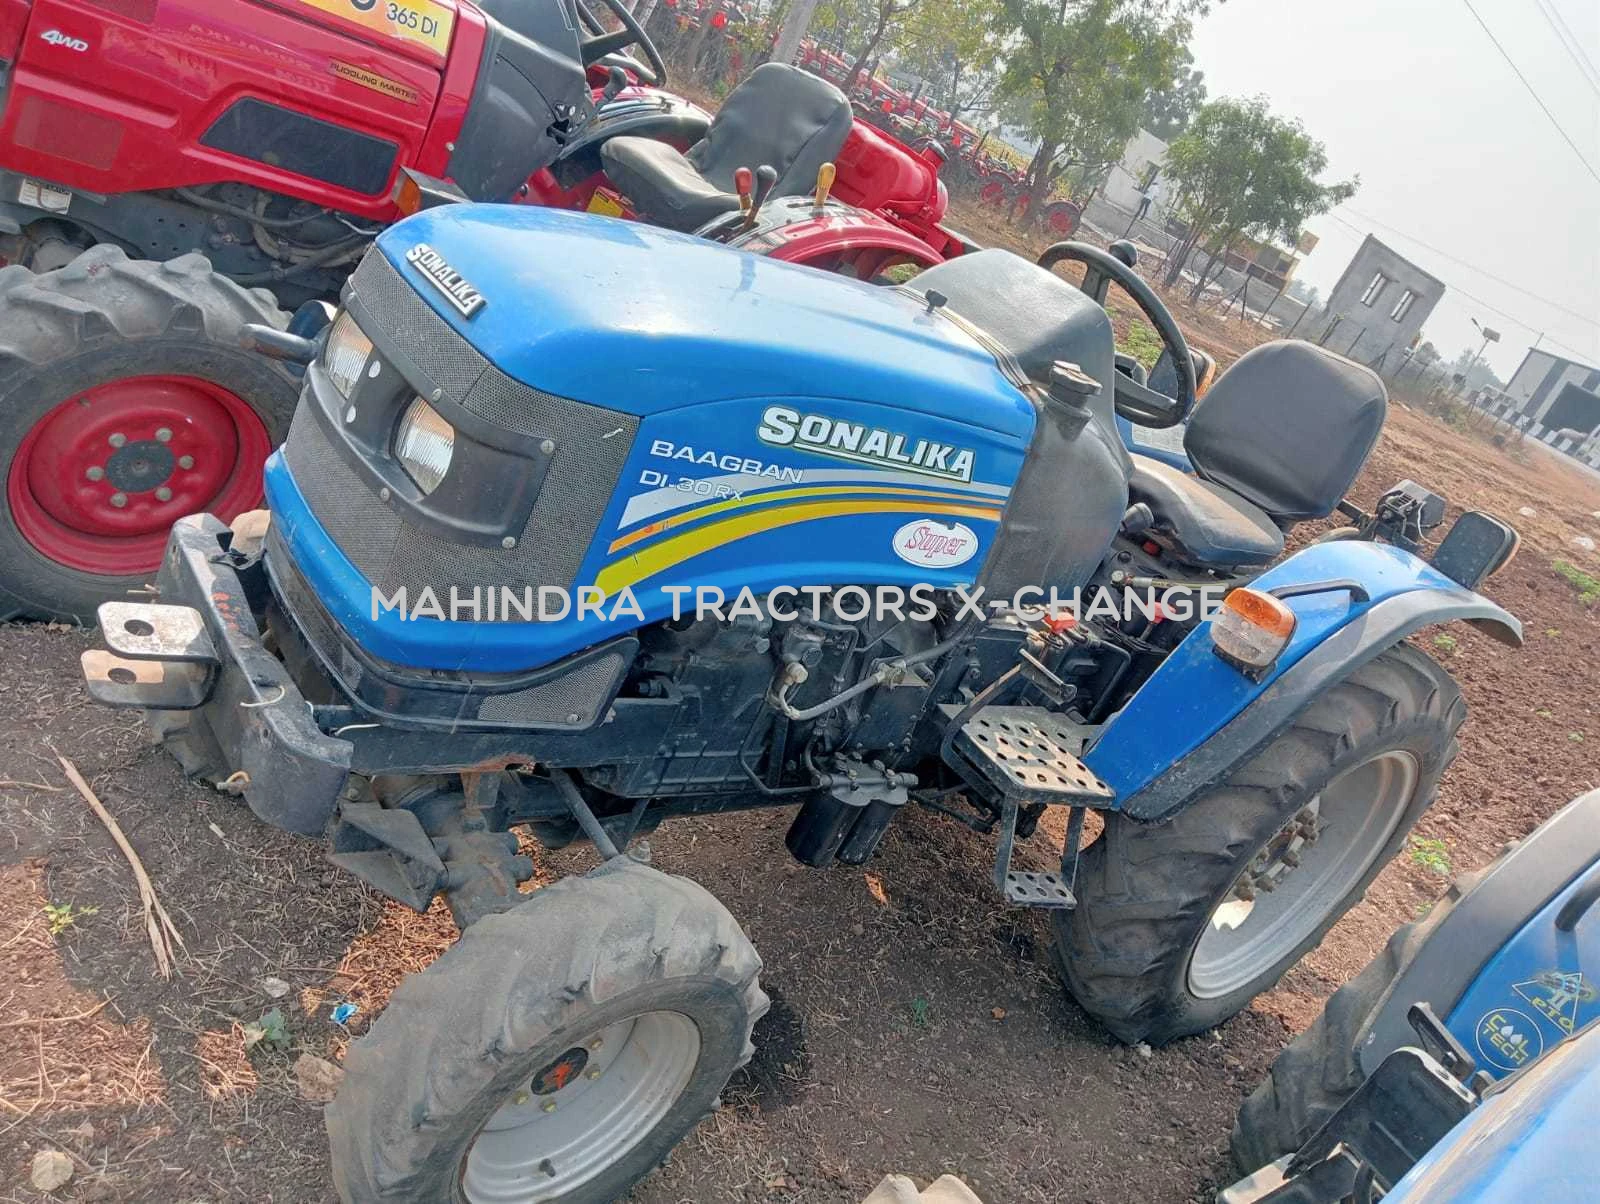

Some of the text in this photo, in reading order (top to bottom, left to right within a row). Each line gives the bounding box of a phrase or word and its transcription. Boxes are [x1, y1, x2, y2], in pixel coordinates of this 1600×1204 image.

[386, 3, 418, 29] 365
[420, 16, 438, 38] DI
[40, 29, 89, 52] 4WD
[379, 81, 418, 101] MASTER
[405, 242, 486, 319] SONALIKA
[649, 438, 804, 485] BAAGBAN
[757, 404, 977, 484] SONALIKA
[903, 525, 968, 559] Super
[1482, 1022, 1526, 1065] TECH
